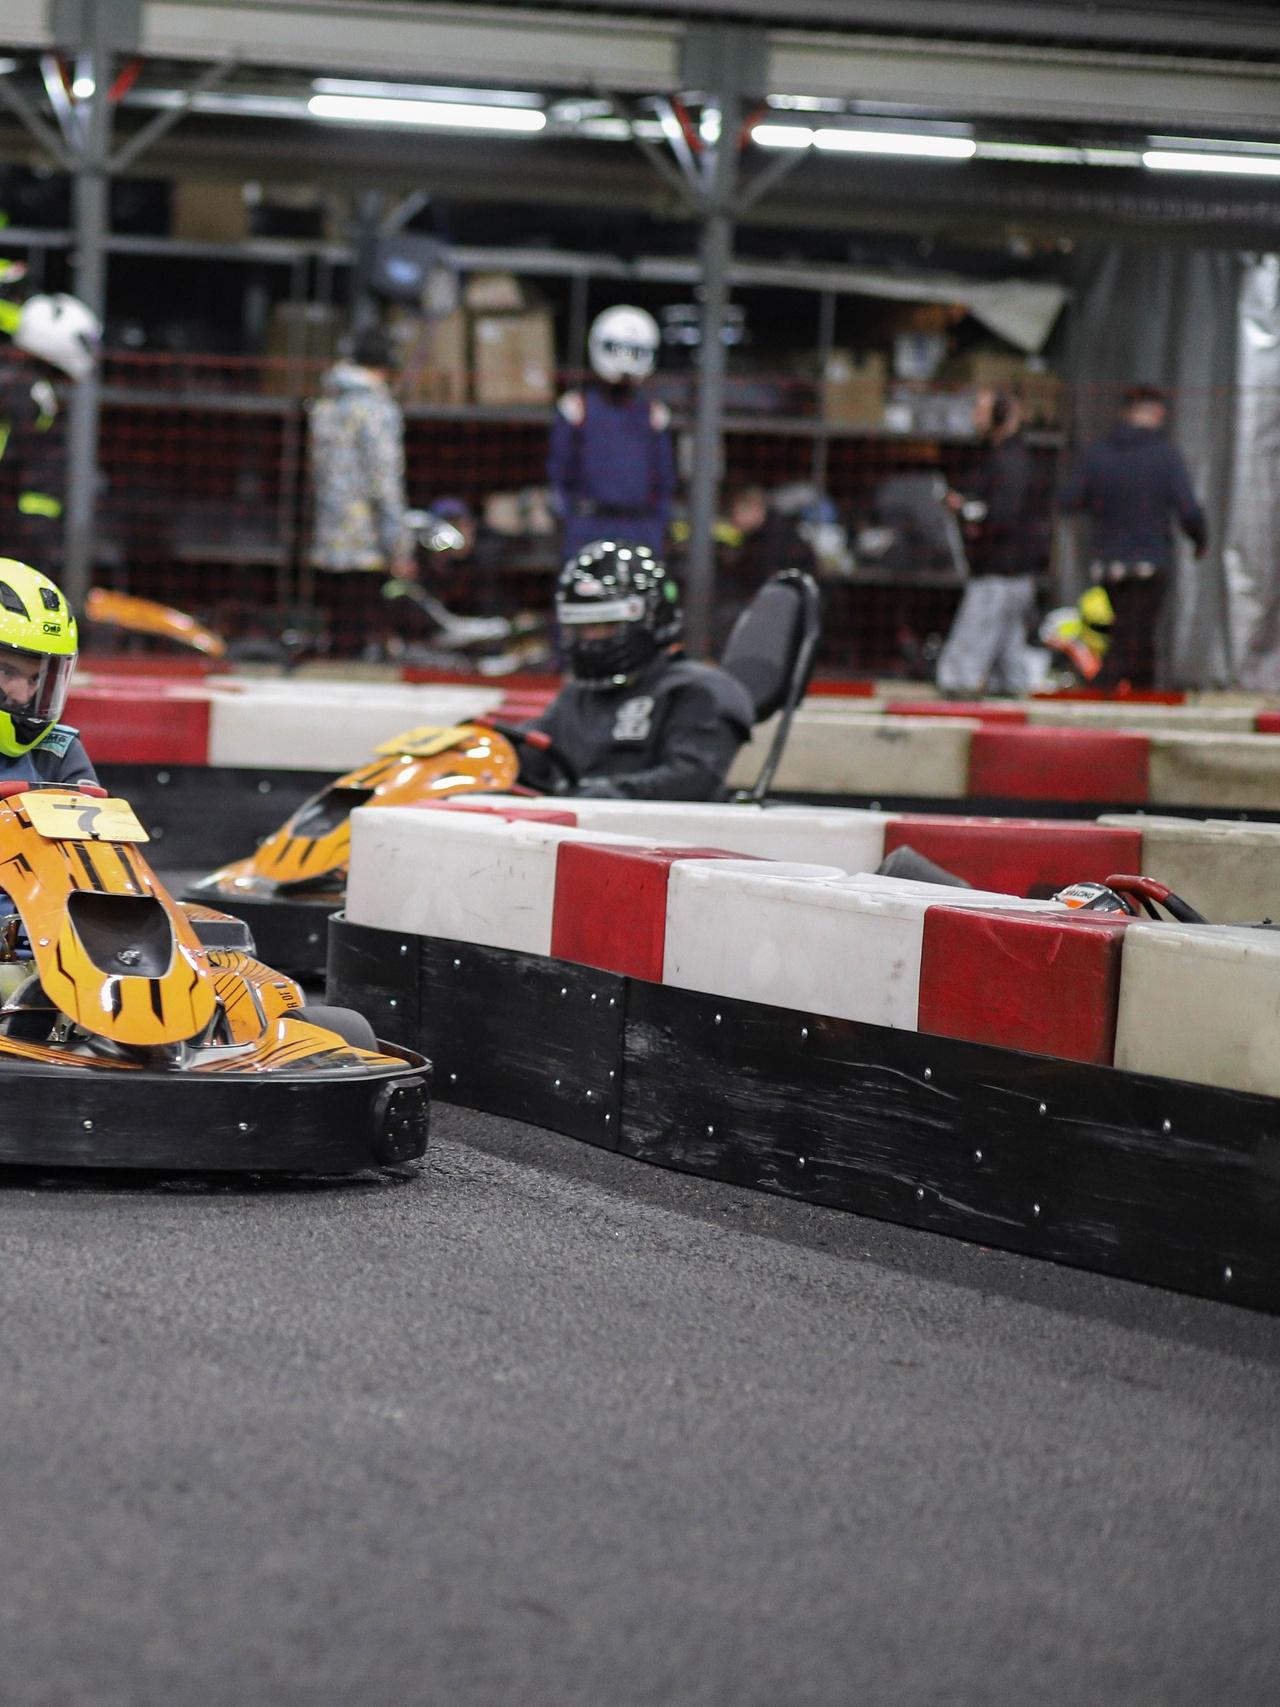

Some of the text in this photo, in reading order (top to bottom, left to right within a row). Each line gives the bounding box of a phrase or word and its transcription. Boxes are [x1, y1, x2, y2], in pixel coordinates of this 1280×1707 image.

[43, 624, 61, 633] OMP
[44, 732, 66, 742] MP
[52, 804, 102, 832] 7
